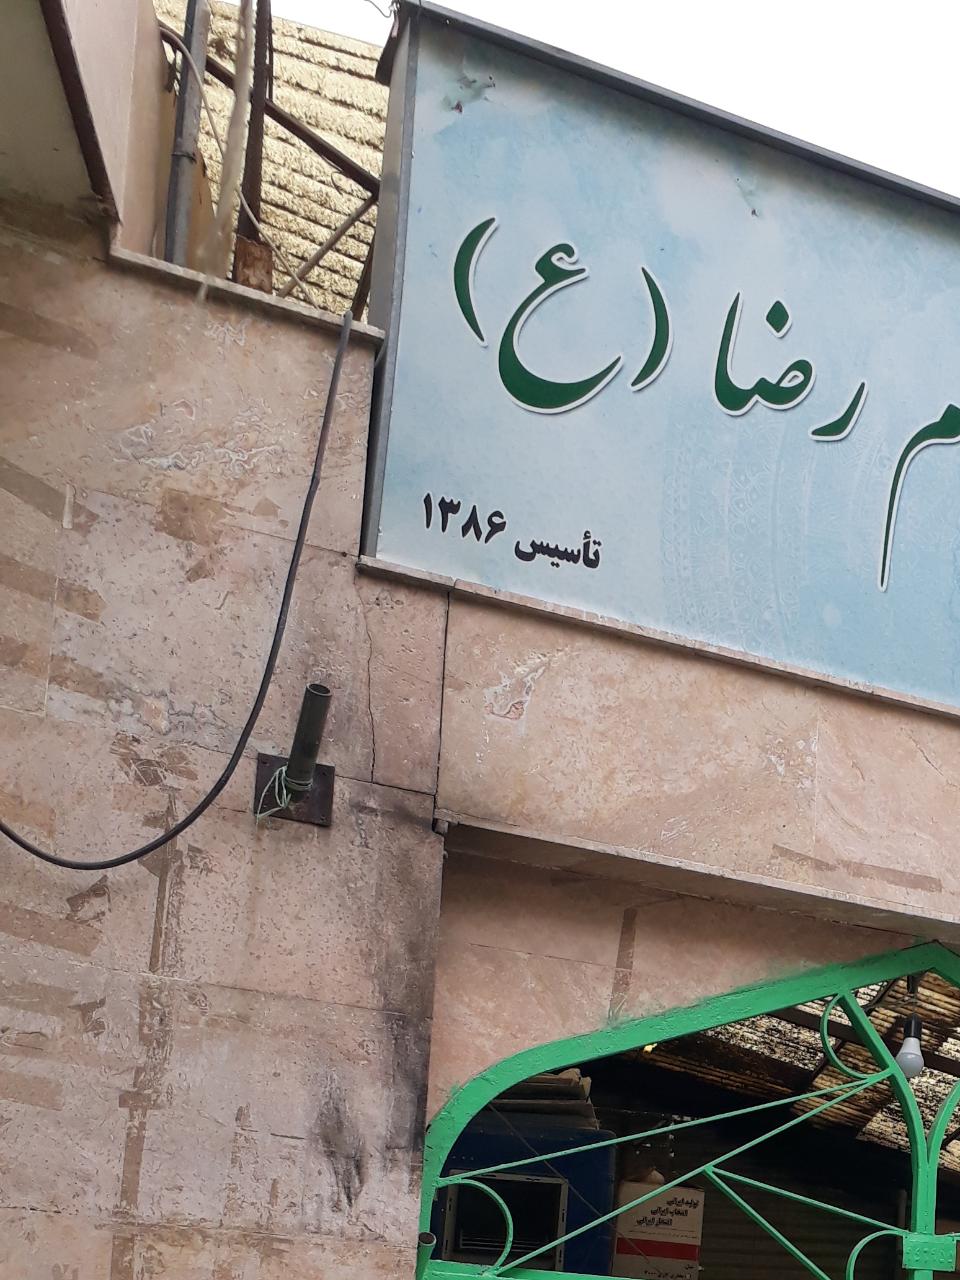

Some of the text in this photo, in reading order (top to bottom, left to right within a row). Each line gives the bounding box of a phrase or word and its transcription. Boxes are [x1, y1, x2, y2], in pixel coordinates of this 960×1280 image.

[452, 216, 674, 414] (ع)
[713, 291, 869, 442] رضا
[421, 492, 507, 545] ۱۳۸۶
